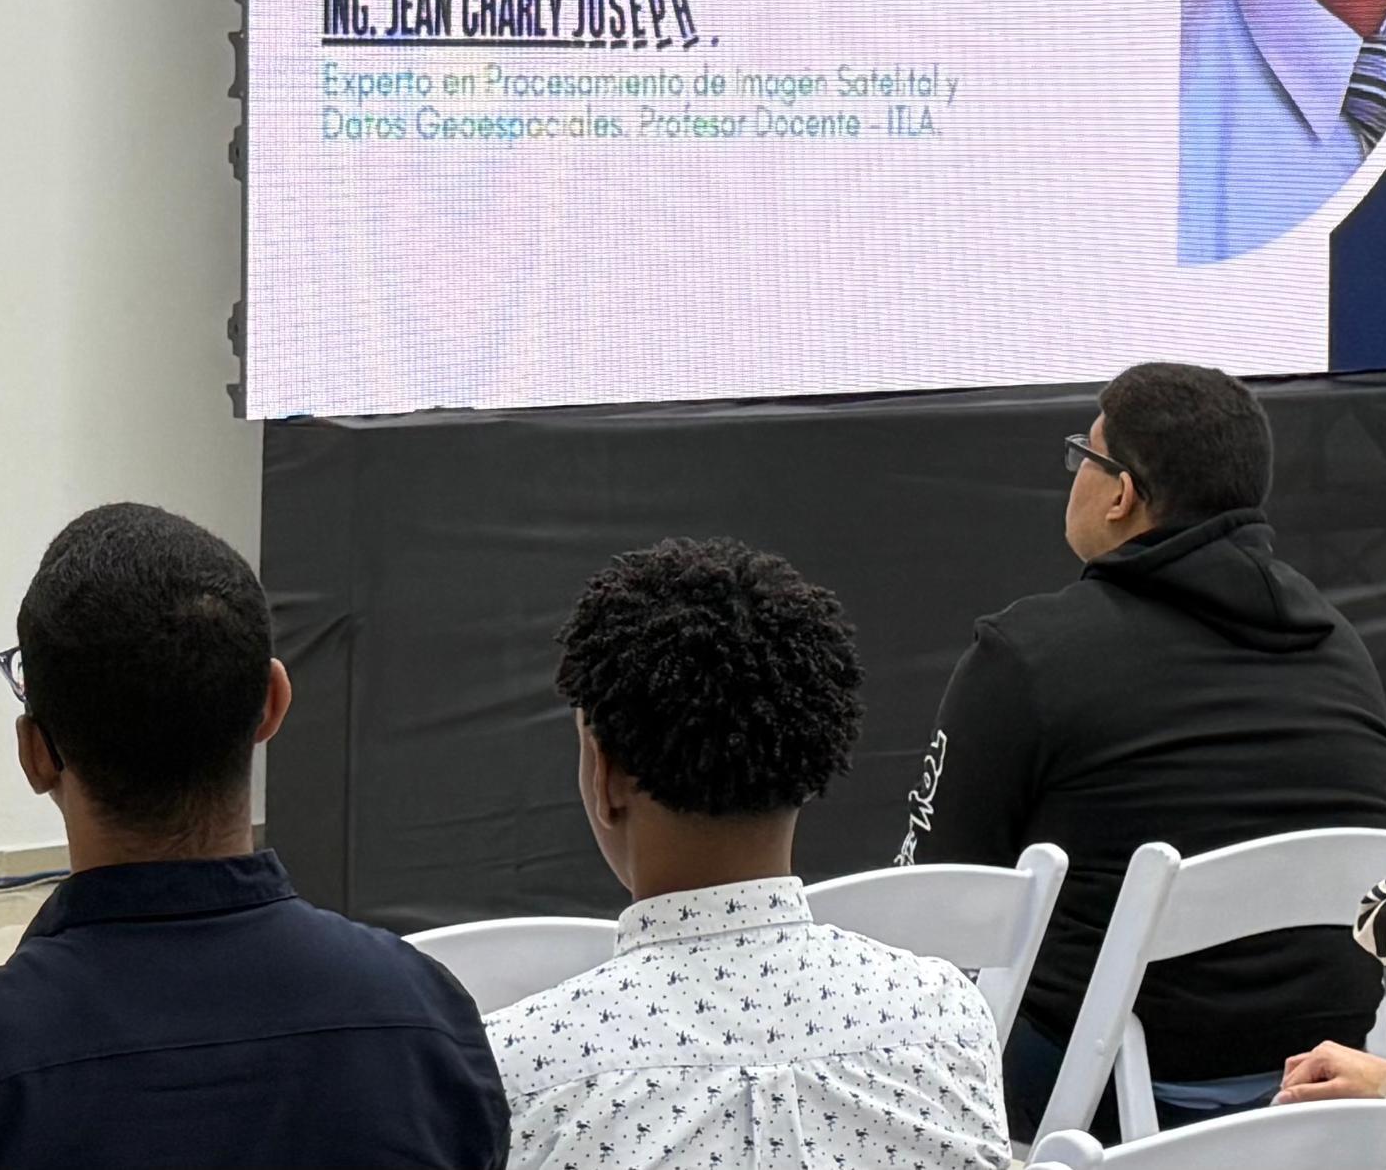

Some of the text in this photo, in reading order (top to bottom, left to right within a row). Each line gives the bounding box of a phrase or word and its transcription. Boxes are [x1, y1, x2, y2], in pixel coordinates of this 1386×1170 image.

[324, 61, 959, 107] Experto en Procesamiento de Imagen Satelital y
[323, 105, 407, 140] Datos
[641, 102, 746, 138] Profesor
[756, 105, 862, 138] Docente
